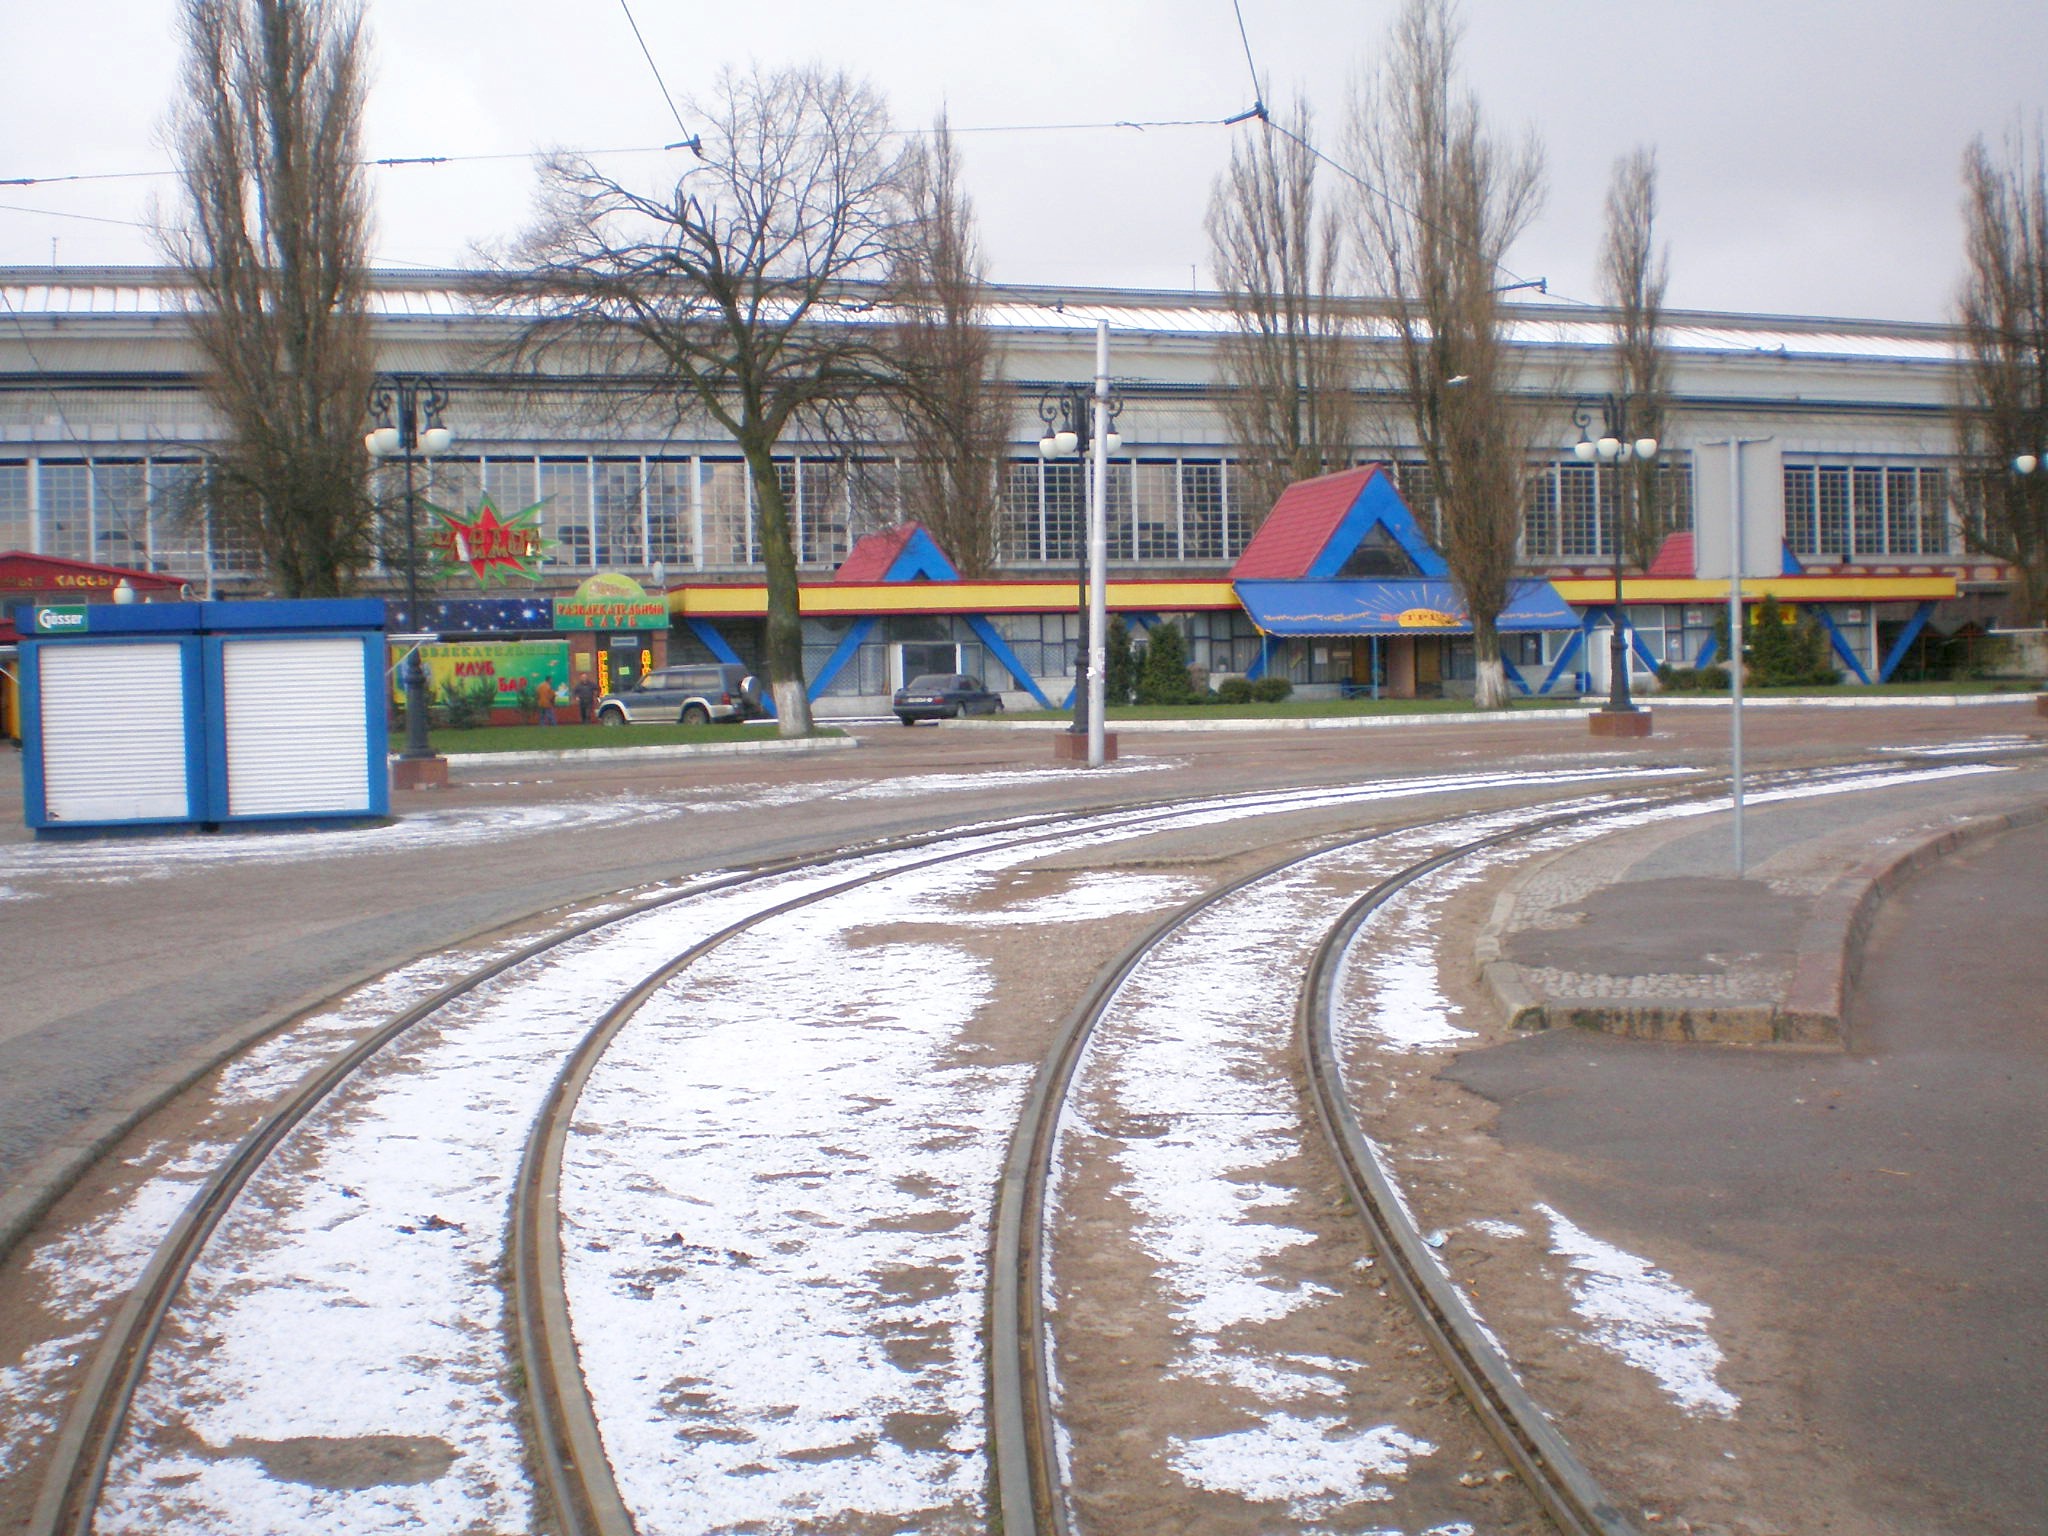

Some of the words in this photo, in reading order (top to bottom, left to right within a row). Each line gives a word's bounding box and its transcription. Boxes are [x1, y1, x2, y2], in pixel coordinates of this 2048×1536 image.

[584, 616, 638, 627] КЛУБ
[455, 660, 496, 677] КЛУБ
[497, 677, 528, 692] БАР
